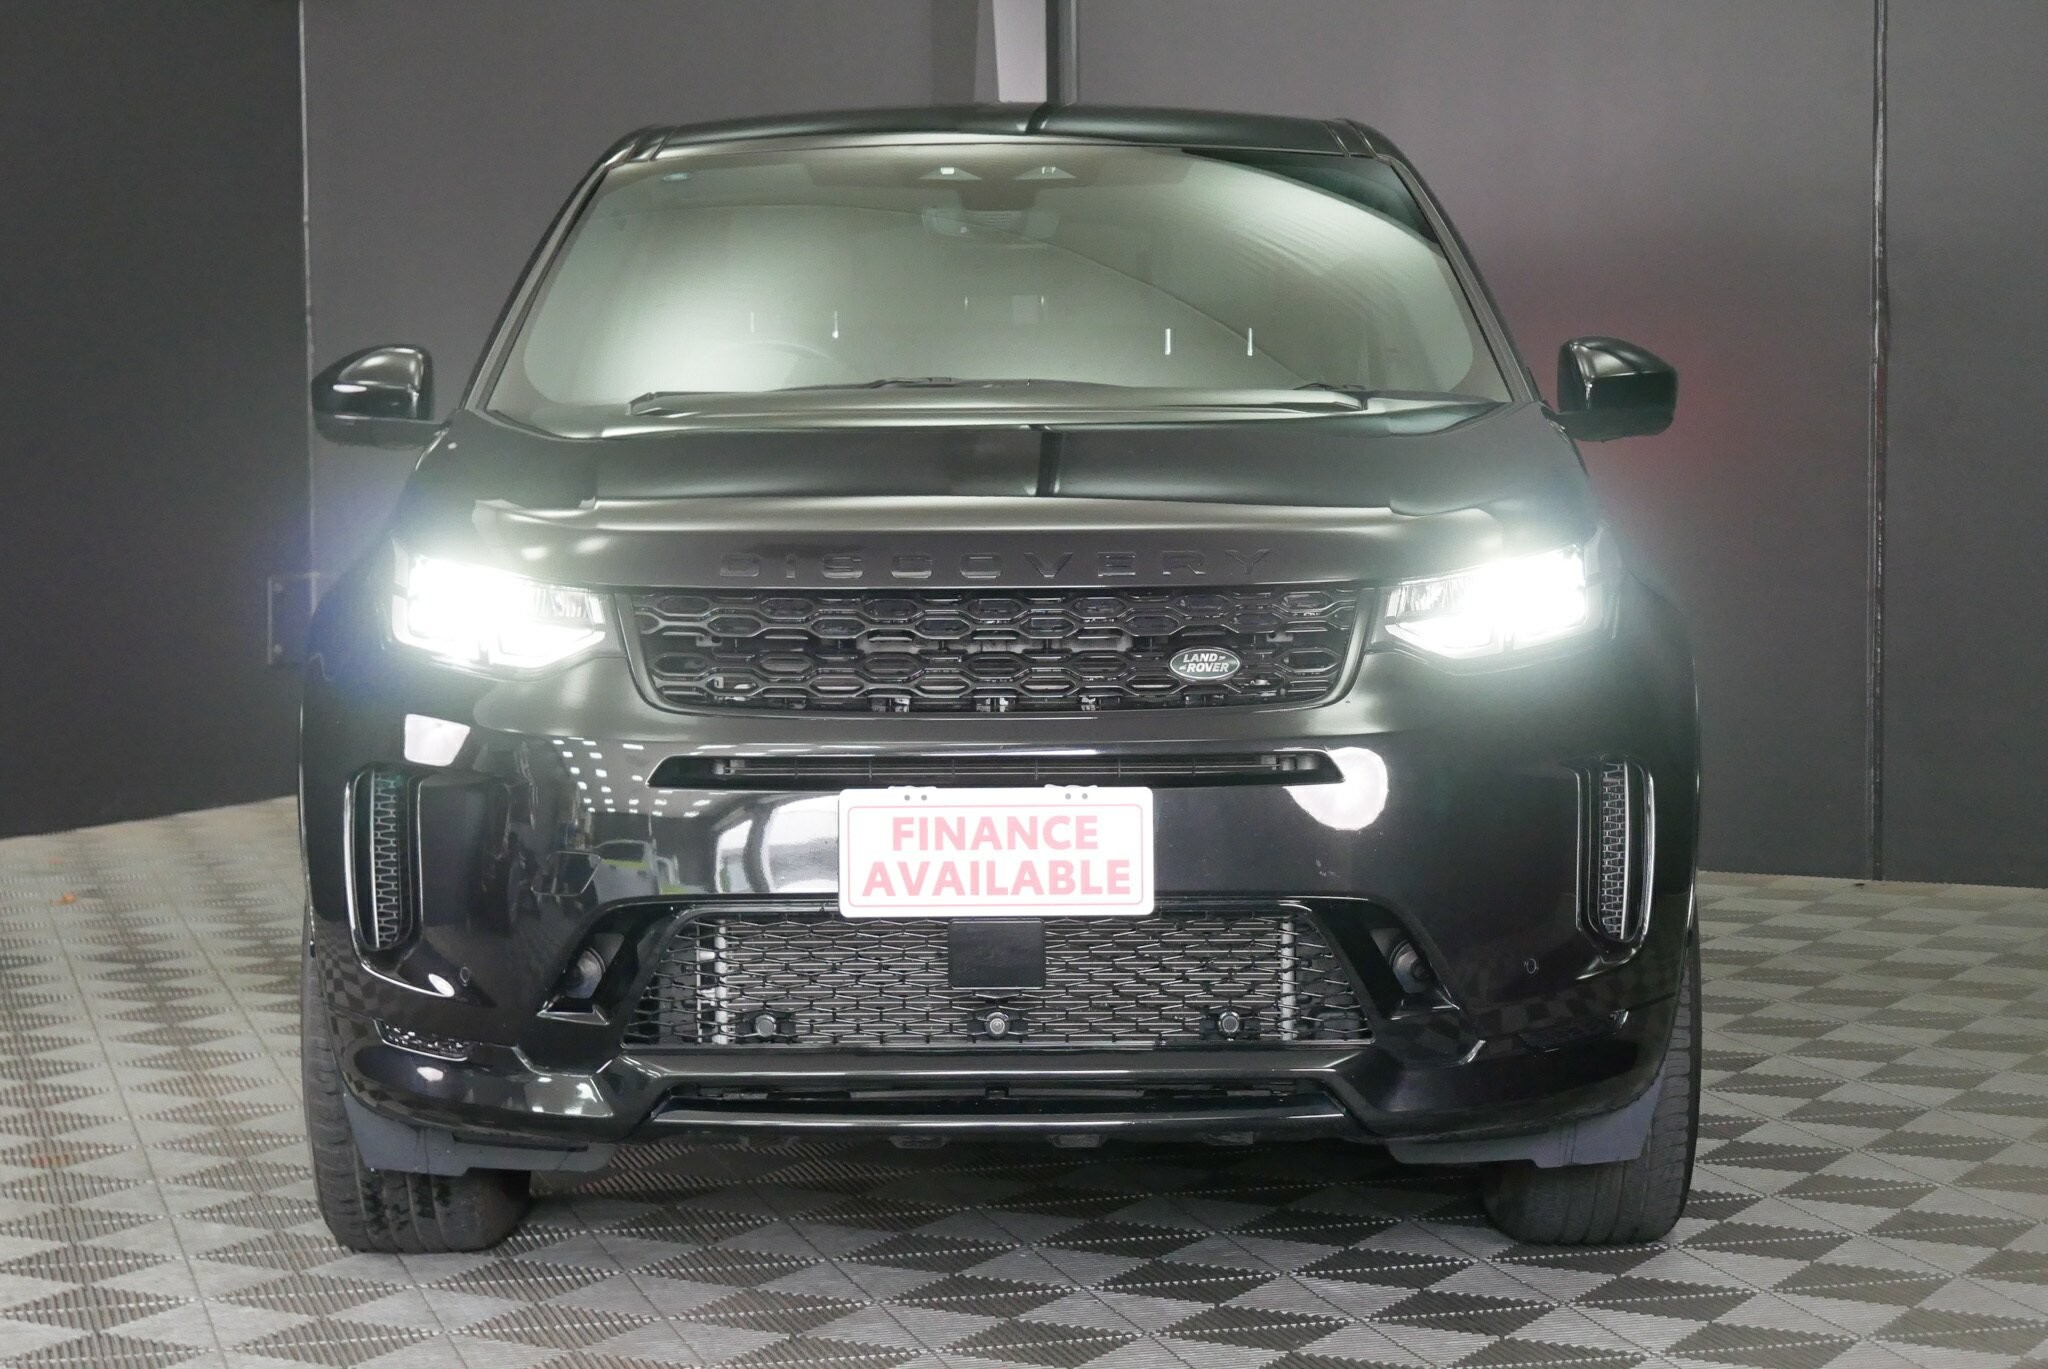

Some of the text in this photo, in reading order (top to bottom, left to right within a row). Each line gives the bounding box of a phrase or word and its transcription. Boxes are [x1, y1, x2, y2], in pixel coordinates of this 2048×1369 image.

[719, 551, 1272, 579] DISCOVERY
[1183, 653, 1218, 663] LAND
[1186, 662, 1229, 673] ROVER
[892, 815, 1098, 851] FINANCE
[862, 859, 1131, 897] AVAILABLE
